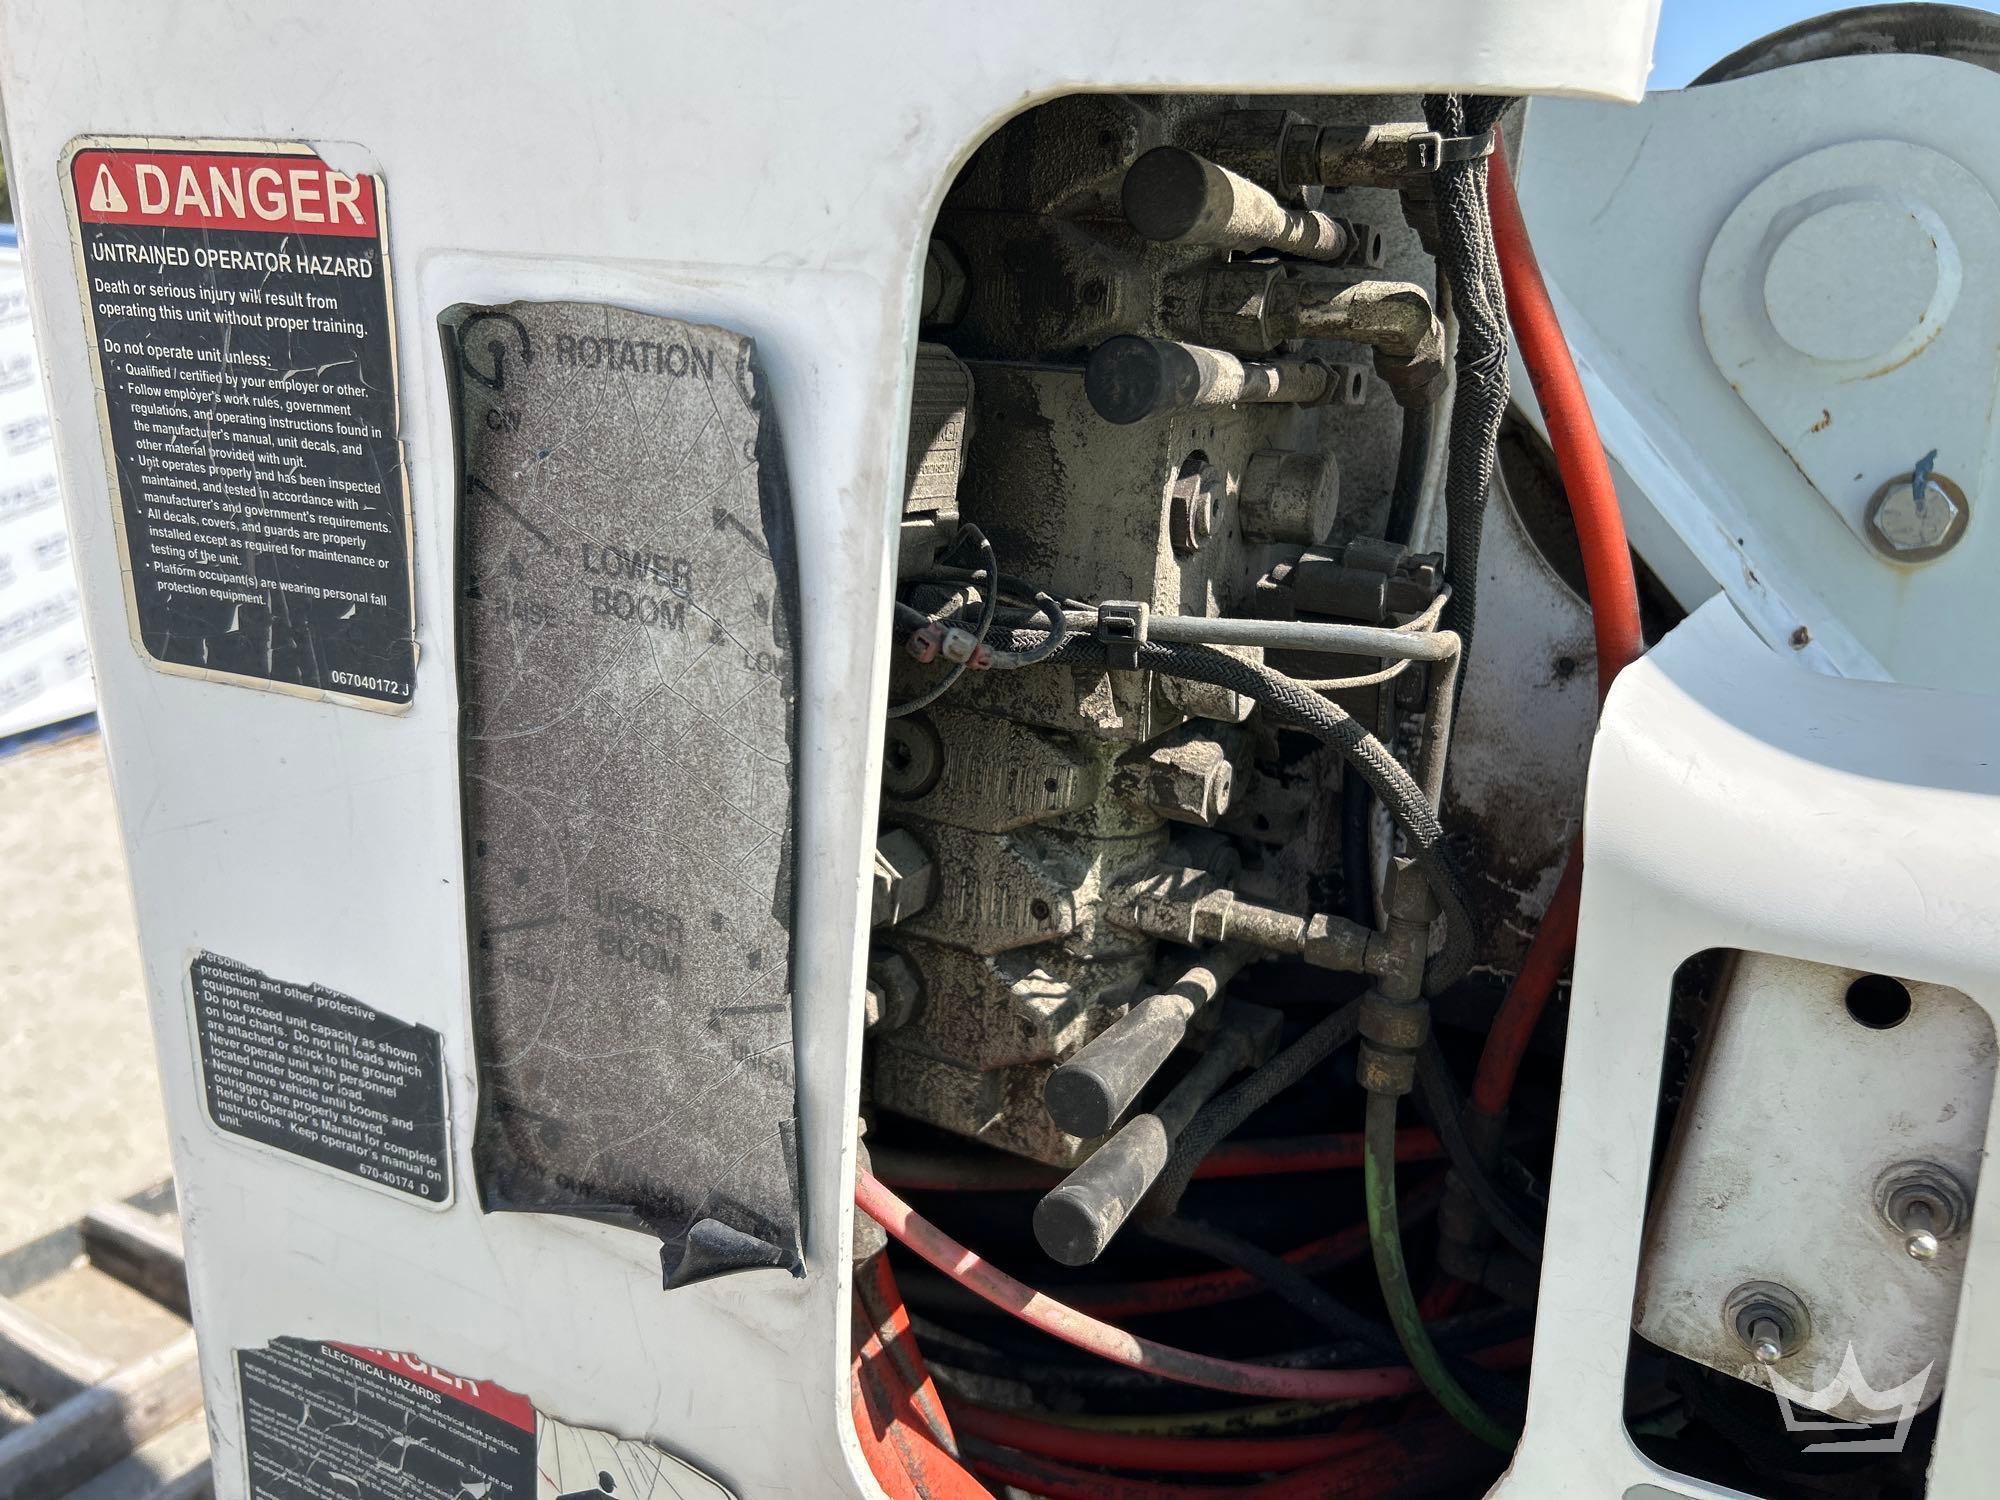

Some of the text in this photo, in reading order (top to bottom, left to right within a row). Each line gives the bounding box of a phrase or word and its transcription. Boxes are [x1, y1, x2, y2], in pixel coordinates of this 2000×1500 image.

[135, 164, 366, 225] DANGER
[92, 242, 373, 278] UNTRAINED OPERATOR HAZARD
[94, 277, 338, 310] Death or serious injury will result from
[98, 302, 368, 339] operating this unit without proper training.
[103, 338, 271, 367] Do not operate unit unless:
[558, 335, 714, 381] ROTATION
[125, 363, 369, 398] Qualified certified by your employer other.
[127, 382, 352, 416] Follow employer's work rules, government
[130, 403, 369, 437] regulations, and operating instructions found
[133, 419, 363, 456] the manufacturer's manual, unit decals, and
[136, 438, 307, 468] other material provided with unit.
[138, 454, 381, 494] Unit operates properly and has been inspected
[141, 474, 359, 510] maintained, and tested accordance with
[144, 493, 392, 533] manufacturer's and government's requirements.
[147, 507, 366, 550] All decals, covers, and guards are properly
[148, 525, 375, 567] installed except required for maintenance
[150, 543, 242, 566] testing the unit.
[582, 543, 691, 588] LOWER
[153, 560, 387, 606] Platform occupant(s) are wearing personal fall
[157, 581, 266, 605] protection equipment.
[591, 586, 686, 632] BOOM
[331, 670, 409, 696] 067040172 J
[200, 965, 375, 1021] protection and other protective
[204, 990, 417, 1062] Do not exceed unit capacity as shown
[205, 1006, 220, 1017] on
[222, 1008, 246, 1025] load
[293, 1029, 310, 1043] Do
[312, 1037, 331, 1050] not
[387, 1060, 422, 1078] which
[207, 1020, 225, 1032] are
[227, 1025, 274, 1046] attached
[340, 1057, 359, 1072] the
[209, 1031, 240, 1049] Never
[243, 1043, 285, 1063] operate
[288, 1057, 309, 1071] unit
[339, 1073, 396, 1098] personnel
[210, 1045, 319, 1087] located under boom
[212, 1058, 243, 1076] Never
[246, 1070, 276, 1087] move
[279, 1081, 318, 1100] vehicle
[349, 1101, 389, 1123] booms
[391, 1117, 413, 1131] and
[214, 1073, 269, 1098] outriggers
[272, 1092, 290, 1104] are
[292, 1099, 339, 1122] properly
[215, 1084, 437, 1166] Refer Operator's Manual complete
[290, 1122, 318, 1142] Keep
[321, 1134, 378, 1160] operator's
[381, 1154, 423, 1175] manual
[426, 1169, 441, 1181] on
[359, 1163, 429, 1195] 670-40174 D
[321, 1345, 386, 1380] ELECTRICAL
[389, 1374, 441, 1404] HAZARDS
